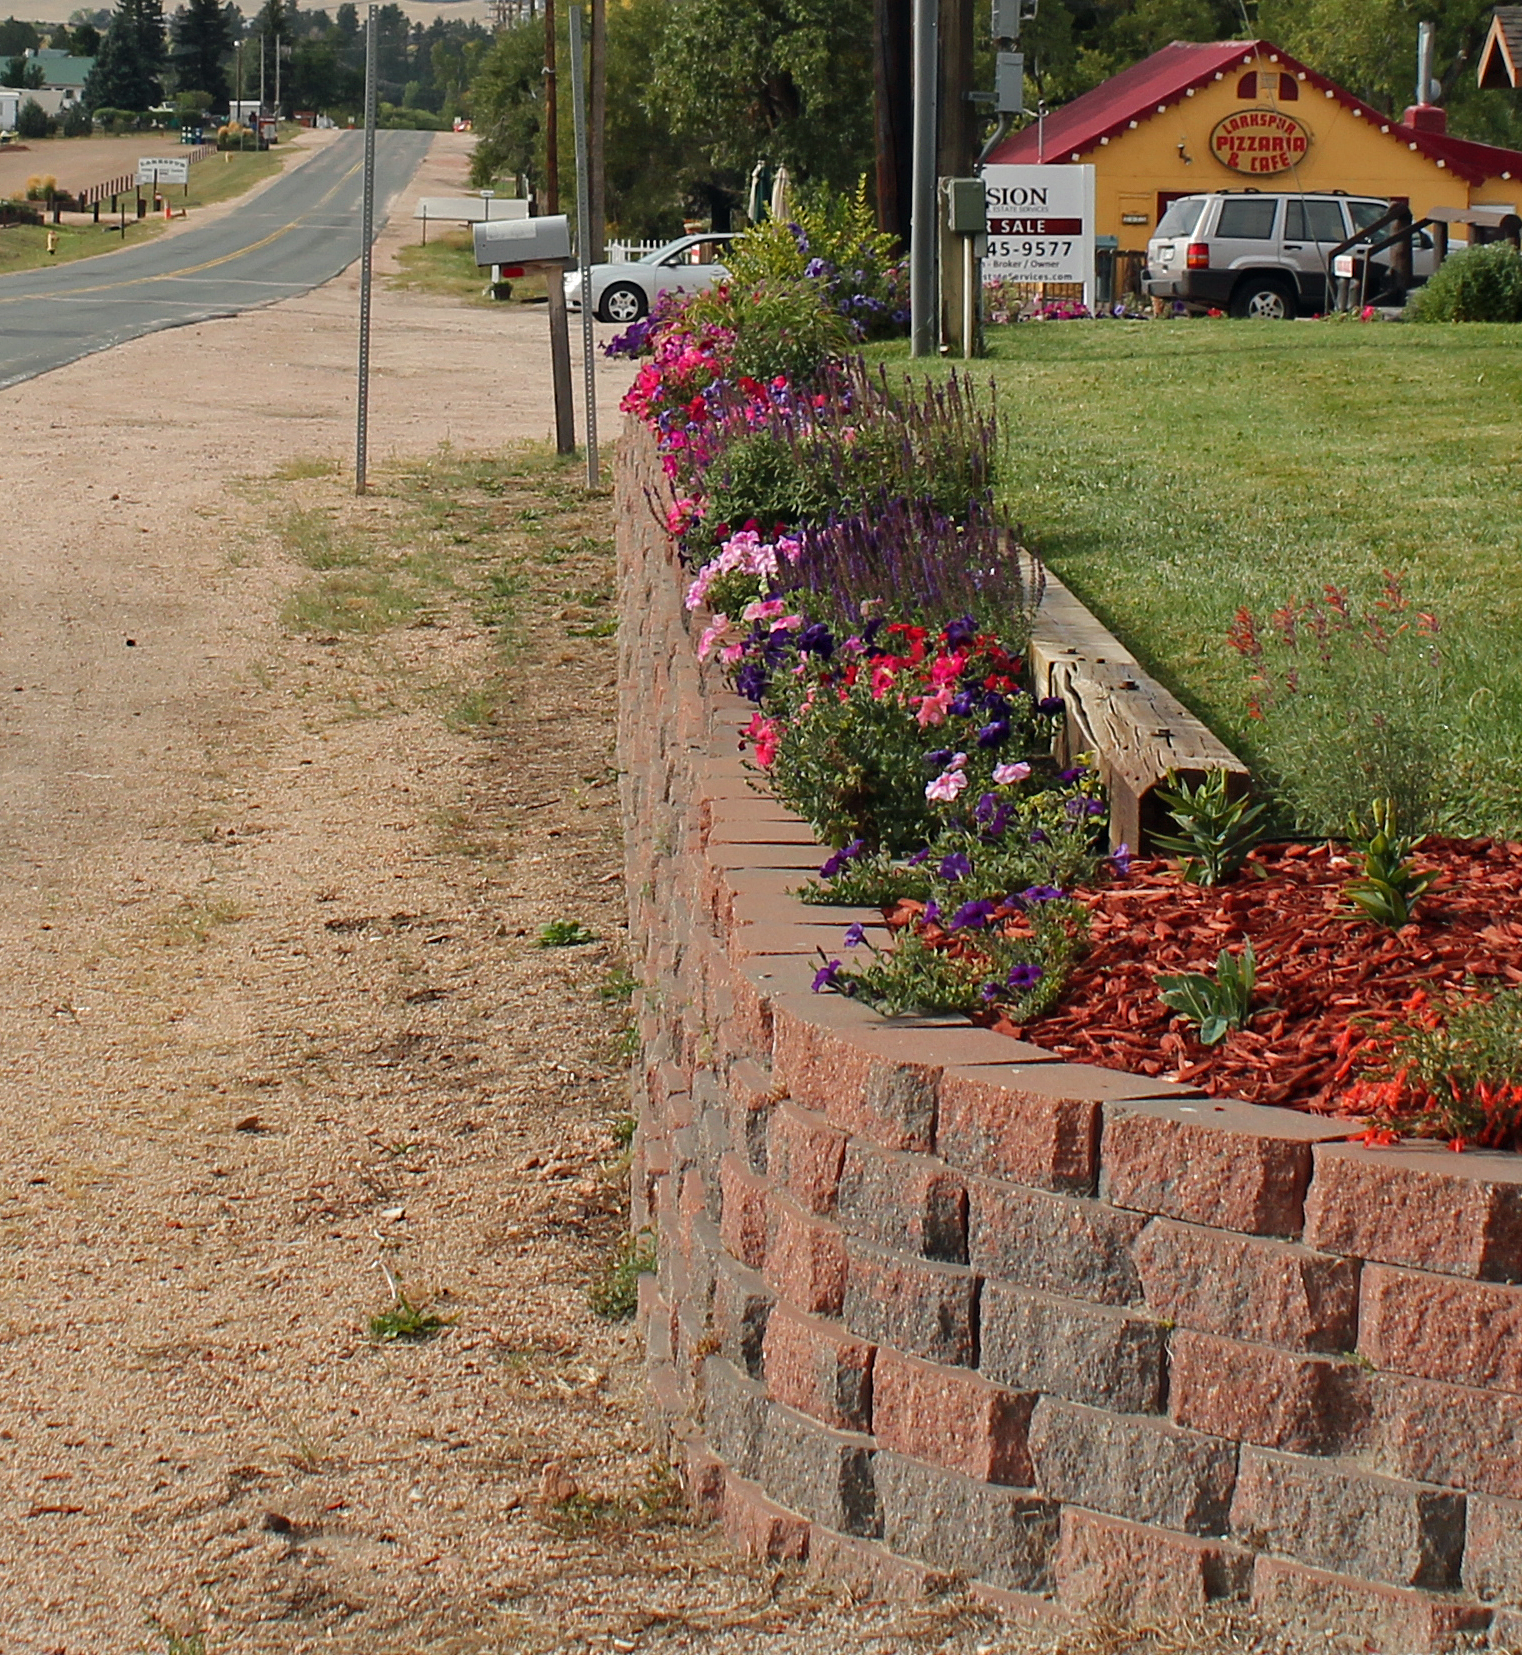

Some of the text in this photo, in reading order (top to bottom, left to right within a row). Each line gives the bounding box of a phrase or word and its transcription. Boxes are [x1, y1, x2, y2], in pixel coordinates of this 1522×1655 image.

[1221, 113, 1296, 135] LARKSPUR
[1216, 136, 1305, 152] PIZZARIA
[1227, 152, 1291, 172] & CAFE
[987, 187, 1048, 205] SION
[1001, 220, 1046, 233] SALE
[987, 241, 1072, 257] 45-9577
[993, 260, 1022, 268] Broker
[1030, 260, 1059, 268] Owner
